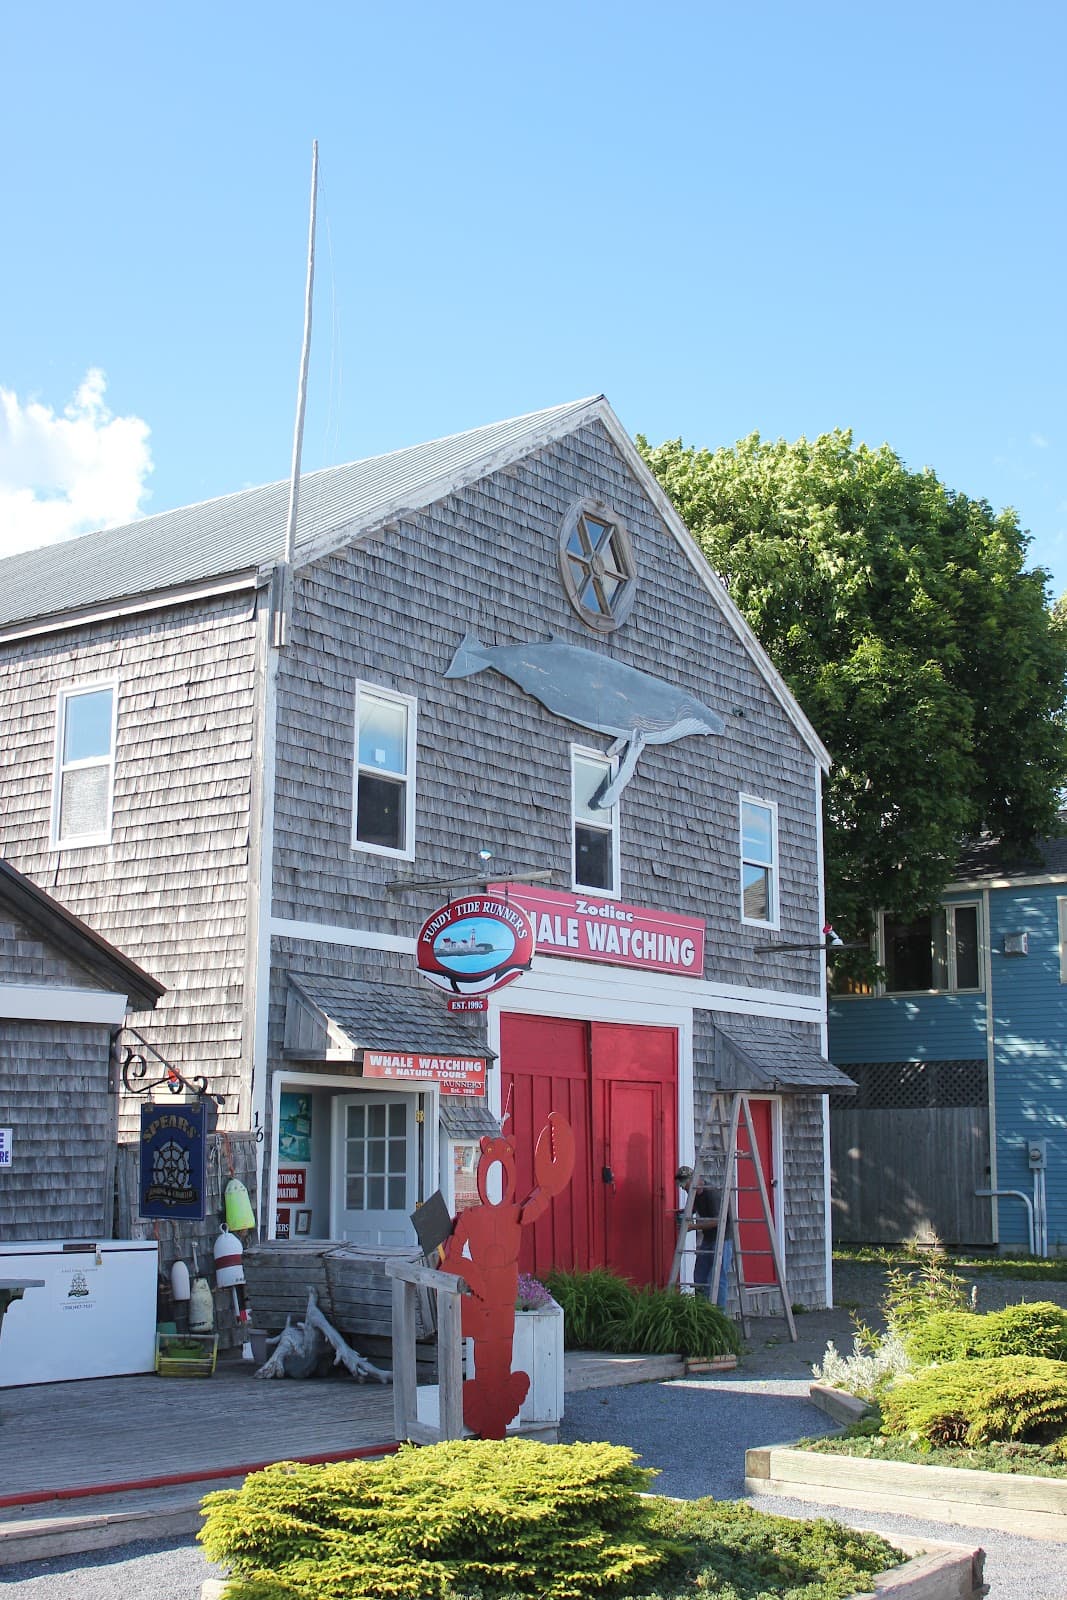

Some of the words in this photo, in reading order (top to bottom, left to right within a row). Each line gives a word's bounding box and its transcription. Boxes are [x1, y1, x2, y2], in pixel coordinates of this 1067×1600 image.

[575, 900, 633, 923] Zodiac
[422, 908, 452, 944] FUNDY
[455, 901, 480, 917] TIDE
[482, 901, 527, 939] RUNNERS
[524, 909, 579, 949] ALE
[585, 920, 695, 967] WATCHING
[369, 1055, 413, 1068] WHALE
[419, 1058, 482, 1072] WATCHING
[384, 1067, 392, 1075] &
[396, 1068, 433, 1077] NATURE
[437, 1071, 467, 1079] TOURS
[278, 1174, 296, 1185] ATIONS
